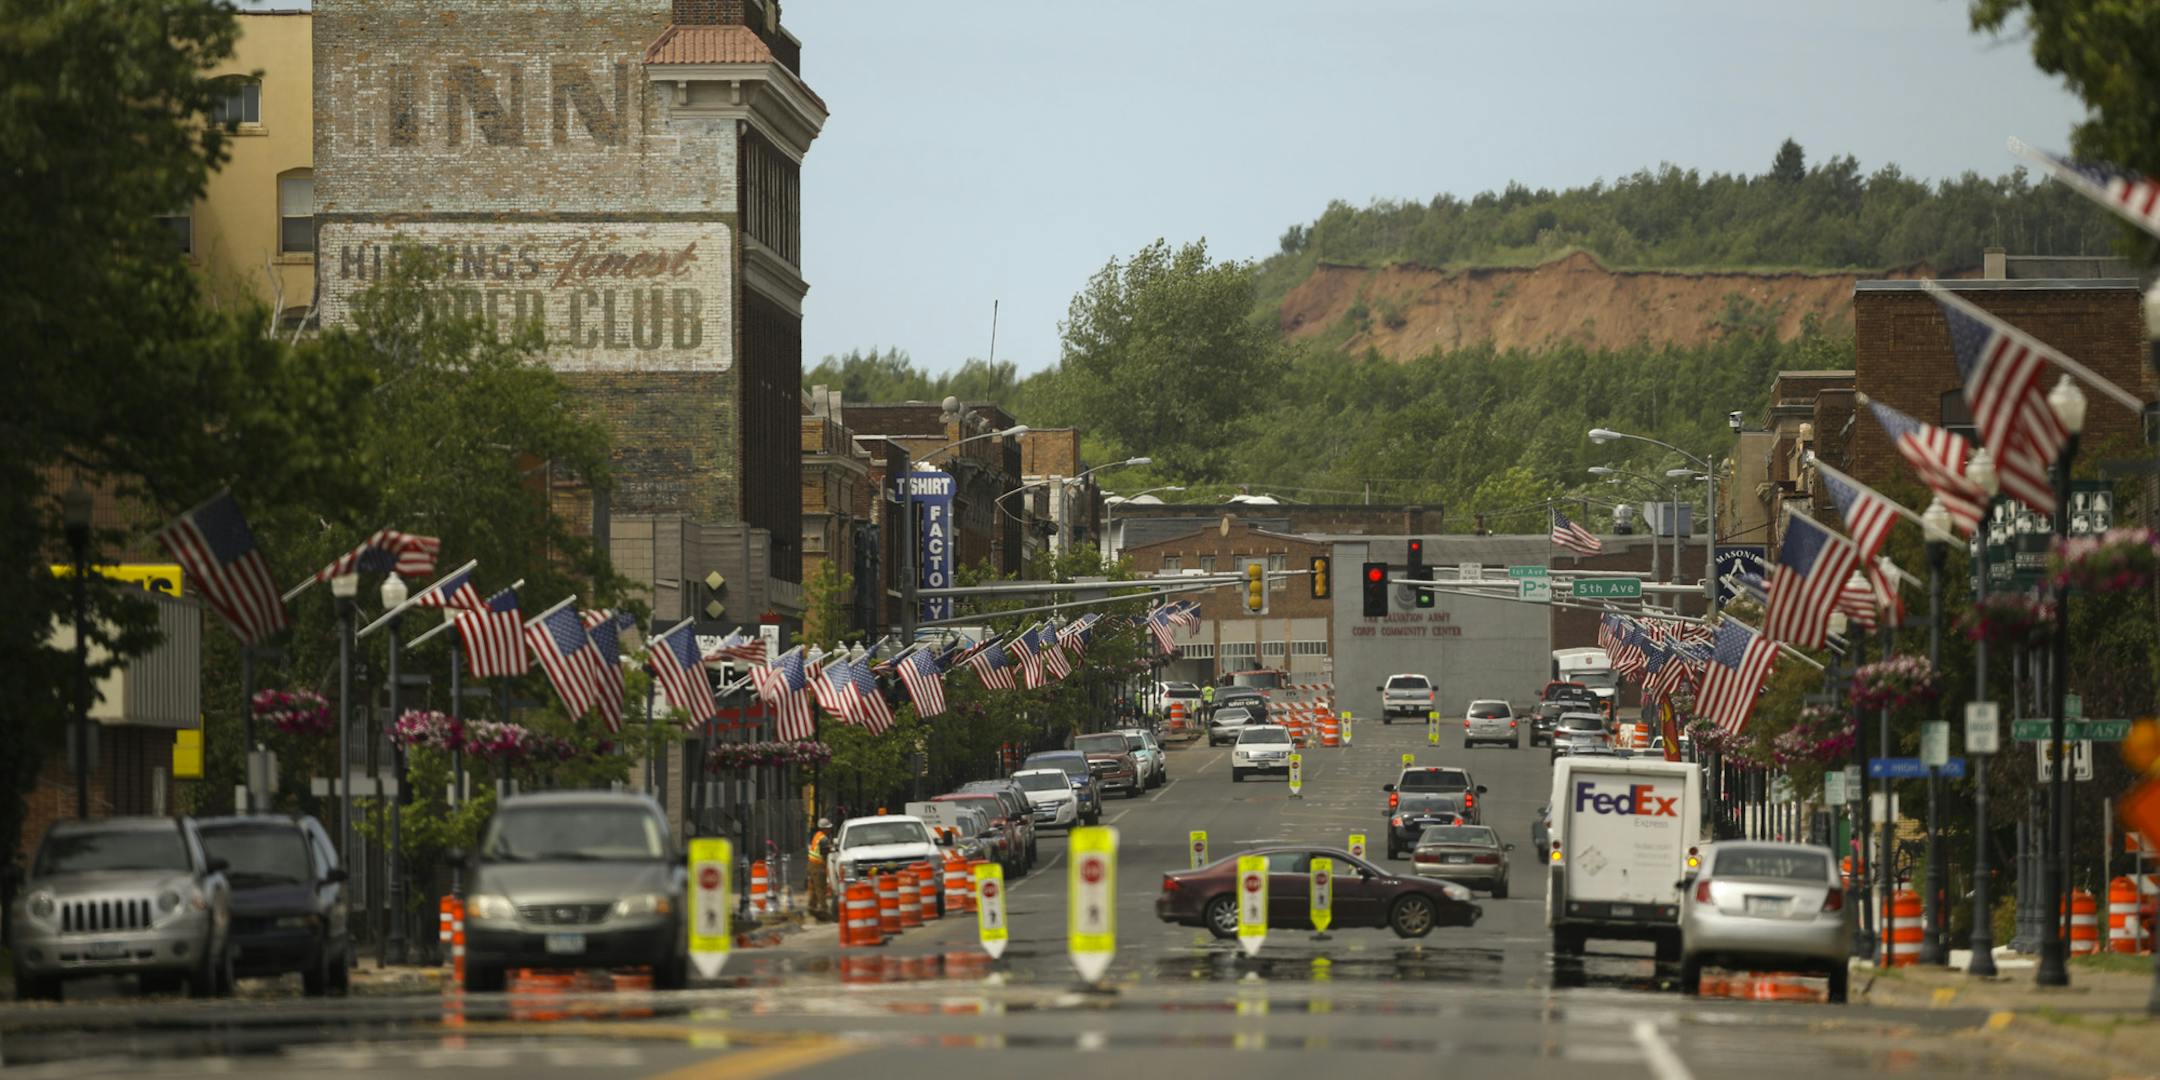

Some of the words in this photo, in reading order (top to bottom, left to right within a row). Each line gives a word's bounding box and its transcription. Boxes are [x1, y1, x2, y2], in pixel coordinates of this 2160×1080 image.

[389, 62, 629, 147] INN
[341, 245, 541, 281] HIINGS
[550, 237, 699, 292] Finest
[569, 288, 703, 351] CLUB
[910, 477, 950, 496] SHIRT
[928, 505, 944, 620] FACTOY
[1527, 567, 1543, 575] Ave
[1523, 580, 1536, 597] P
[1579, 583, 1603, 593] 5th
[1610, 583, 1635, 593] Ave
[2042, 725, 2076, 737] AE
[1575, 782, 1679, 817] FedEx
